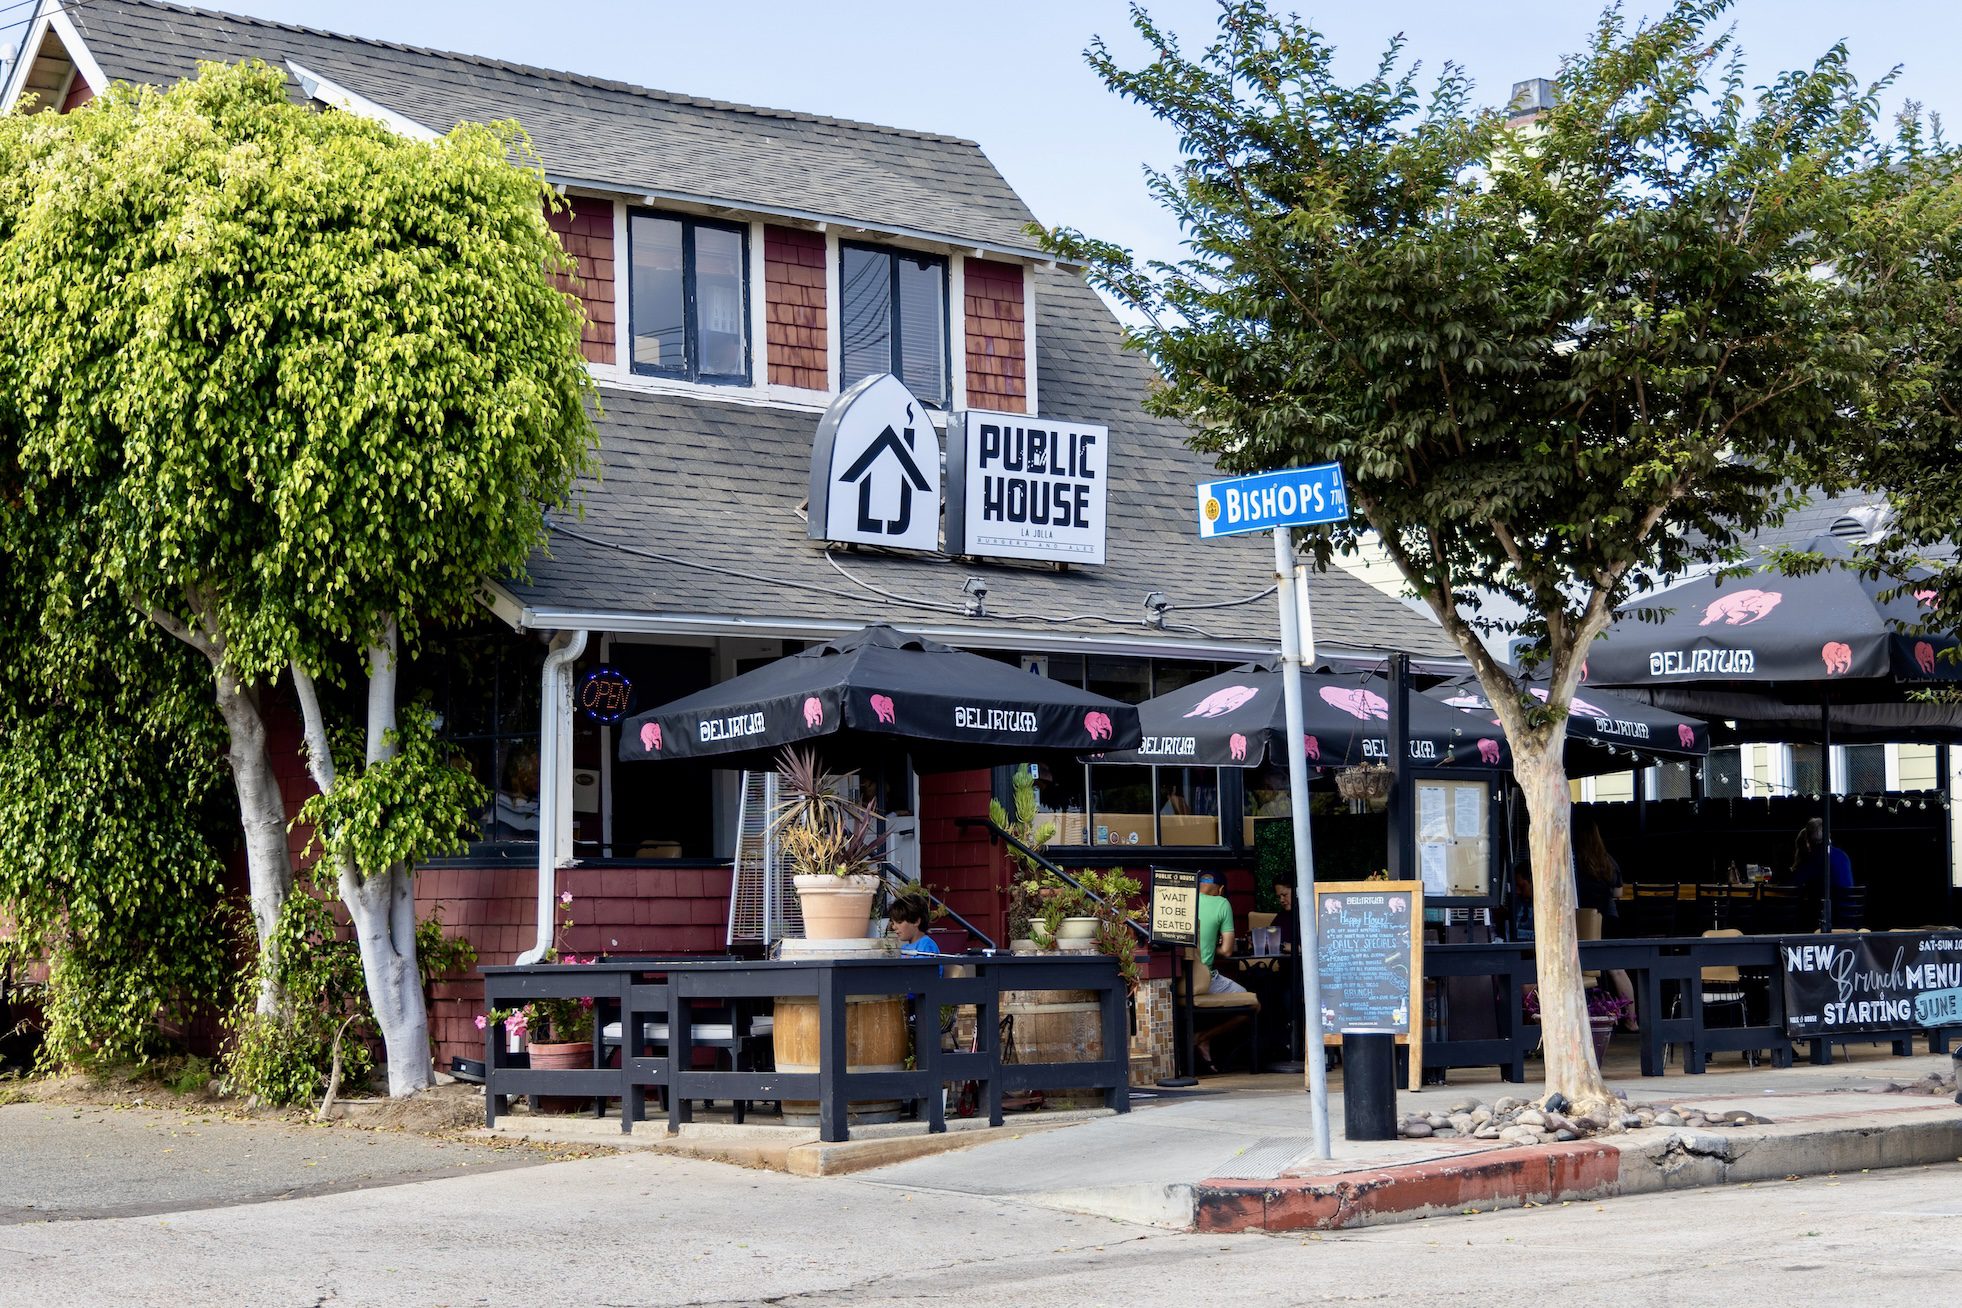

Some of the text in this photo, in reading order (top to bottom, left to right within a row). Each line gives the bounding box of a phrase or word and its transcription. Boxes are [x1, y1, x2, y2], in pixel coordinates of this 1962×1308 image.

[979, 423, 1096, 479] PUBLIC
[983, 475, 1090, 529] HOUSE
[1225, 481, 1325, 524] BISHOPS
[977, 538, 1028, 547] BURGERS
[1021, 527, 1053, 539] LA JOLLA
[1649, 649, 1754, 676] DELIRIUM
[582, 680, 632, 710] OPEN
[699, 711, 766, 742] DELIRIUM
[955, 706, 1038, 732] DELIRIUM
[1593, 717, 1649, 739] DELIRIUM
[1362, 739, 1436, 758] DELUM
[1162, 893, 1187, 903] WAIT
[1160, 906, 1187, 917] TO BE
[1339, 910, 1361, 928] Happy
[1157, 920, 1192, 931] SEATED
[1332, 938, 1397, 949] DAILY SPECIALS
[1918, 939, 1954, 952] SAT-SUN
[1787, 944, 1961, 1003] NEW Brunch MENU
[1823, 995, 1957, 1025] STARTING JUNE
